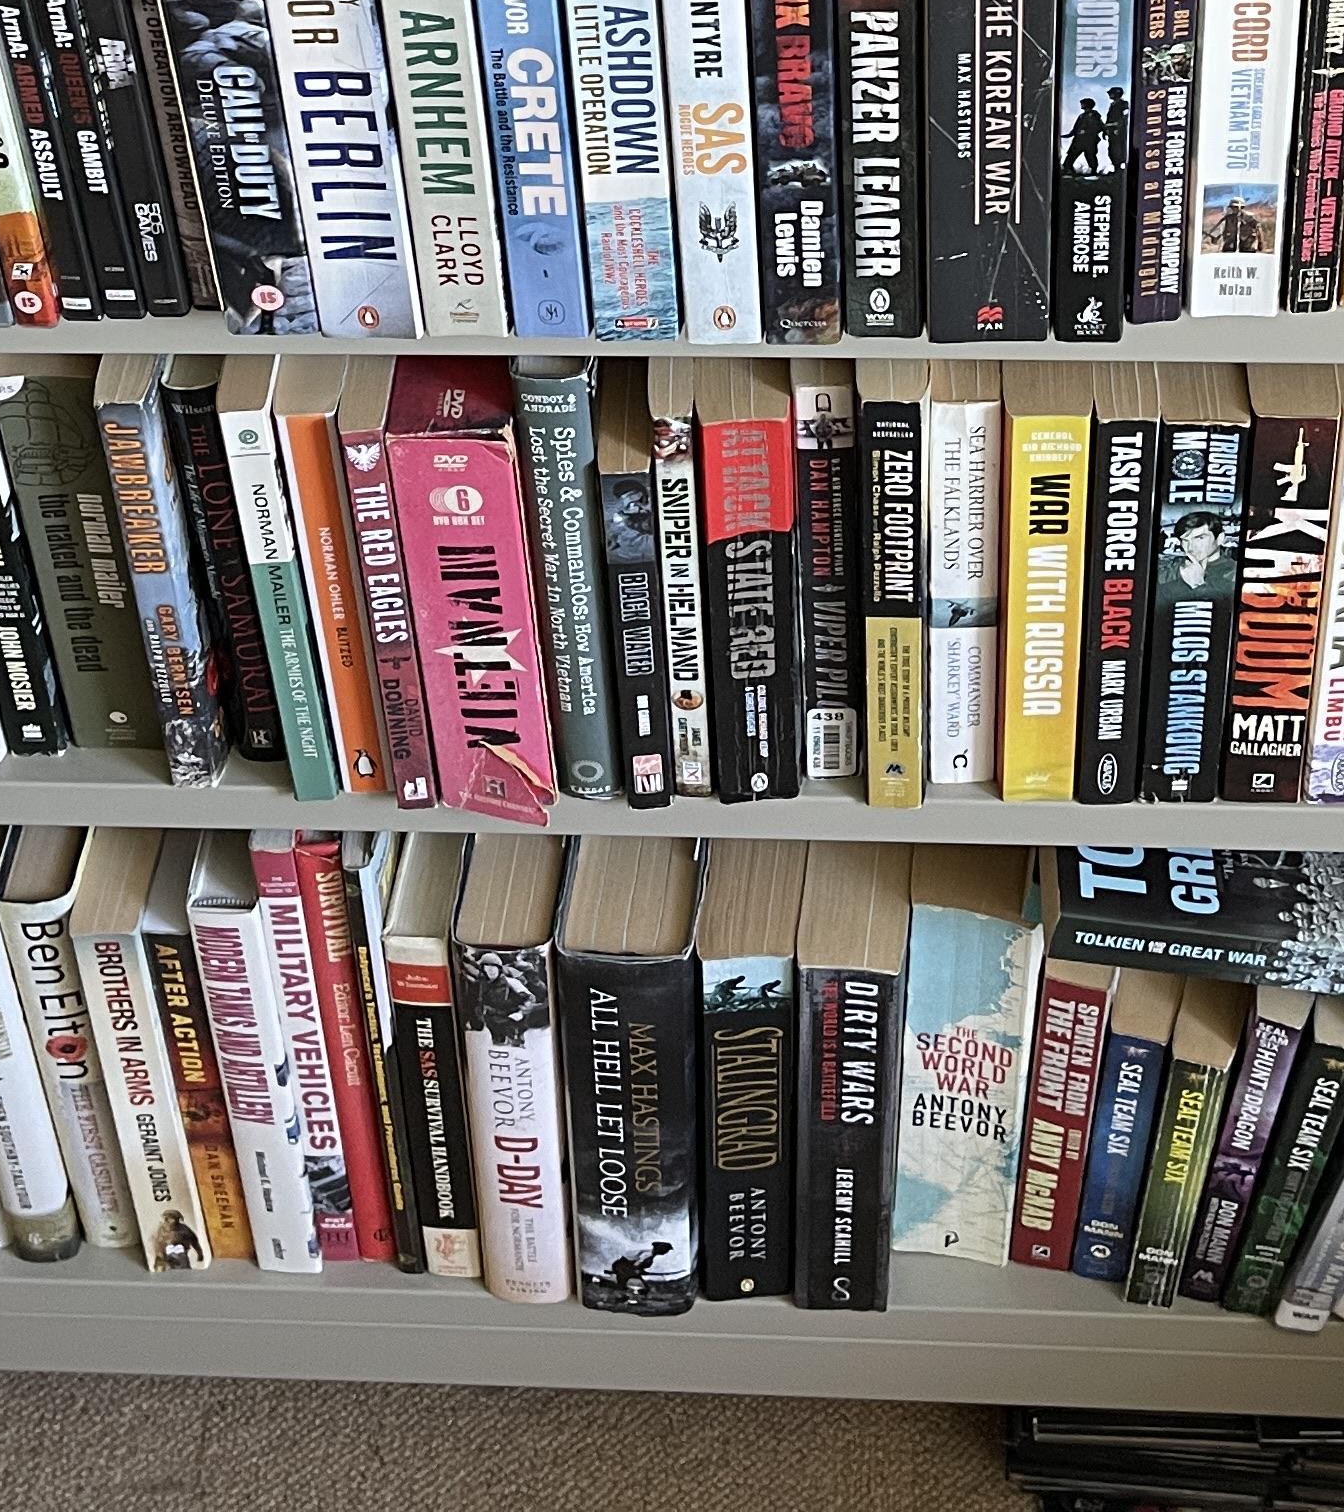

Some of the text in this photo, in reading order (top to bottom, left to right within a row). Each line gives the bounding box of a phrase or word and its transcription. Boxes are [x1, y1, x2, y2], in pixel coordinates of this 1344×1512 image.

[400, 10, 475, 196] ARNHEM
[604, 6, 658, 174] ASHDOWN
[957, 53, 971, 160] MAX HASTINGS
[985, 50, 1011, 148] KOREAN
[294, 72, 398, 262] BERLIN
[507, 48, 567, 216] CRETE
[692, 103, 747, 176] SAS
[850, 10, 901, 279] PANZER LEADER
[985, 157, 1010, 216] WAR
[102, 423, 168, 576] JAWBREAKER
[1100, 432, 1142, 652] TASK FORCE BLACK
[1022, 473, 1071, 717] WAR WITH RUSSIA
[812, 712, 844, 722] 438
[1230, 740, 1302, 758] GALLAGHER
[1232, 714, 1305, 743] MATT
[1074, 932, 1144, 952] TOLKIEN
[916, 1032, 1012, 1068] SECOND
[921, 1050, 1007, 1084] WORLD
[955, 1026, 978, 1038] THE
[487, 1049, 515, 1129] BEEVOR
[514, 1044, 535, 1136] ANTONY
[714, 1027, 784, 1170] STALINGRAD
[914, 1094, 1007, 1123] ANTONY
[936, 1072, 990, 1100] WAR
[911, 1110, 1006, 1140] BEEVOR
[494, 1136, 544, 1209] D-DAY
